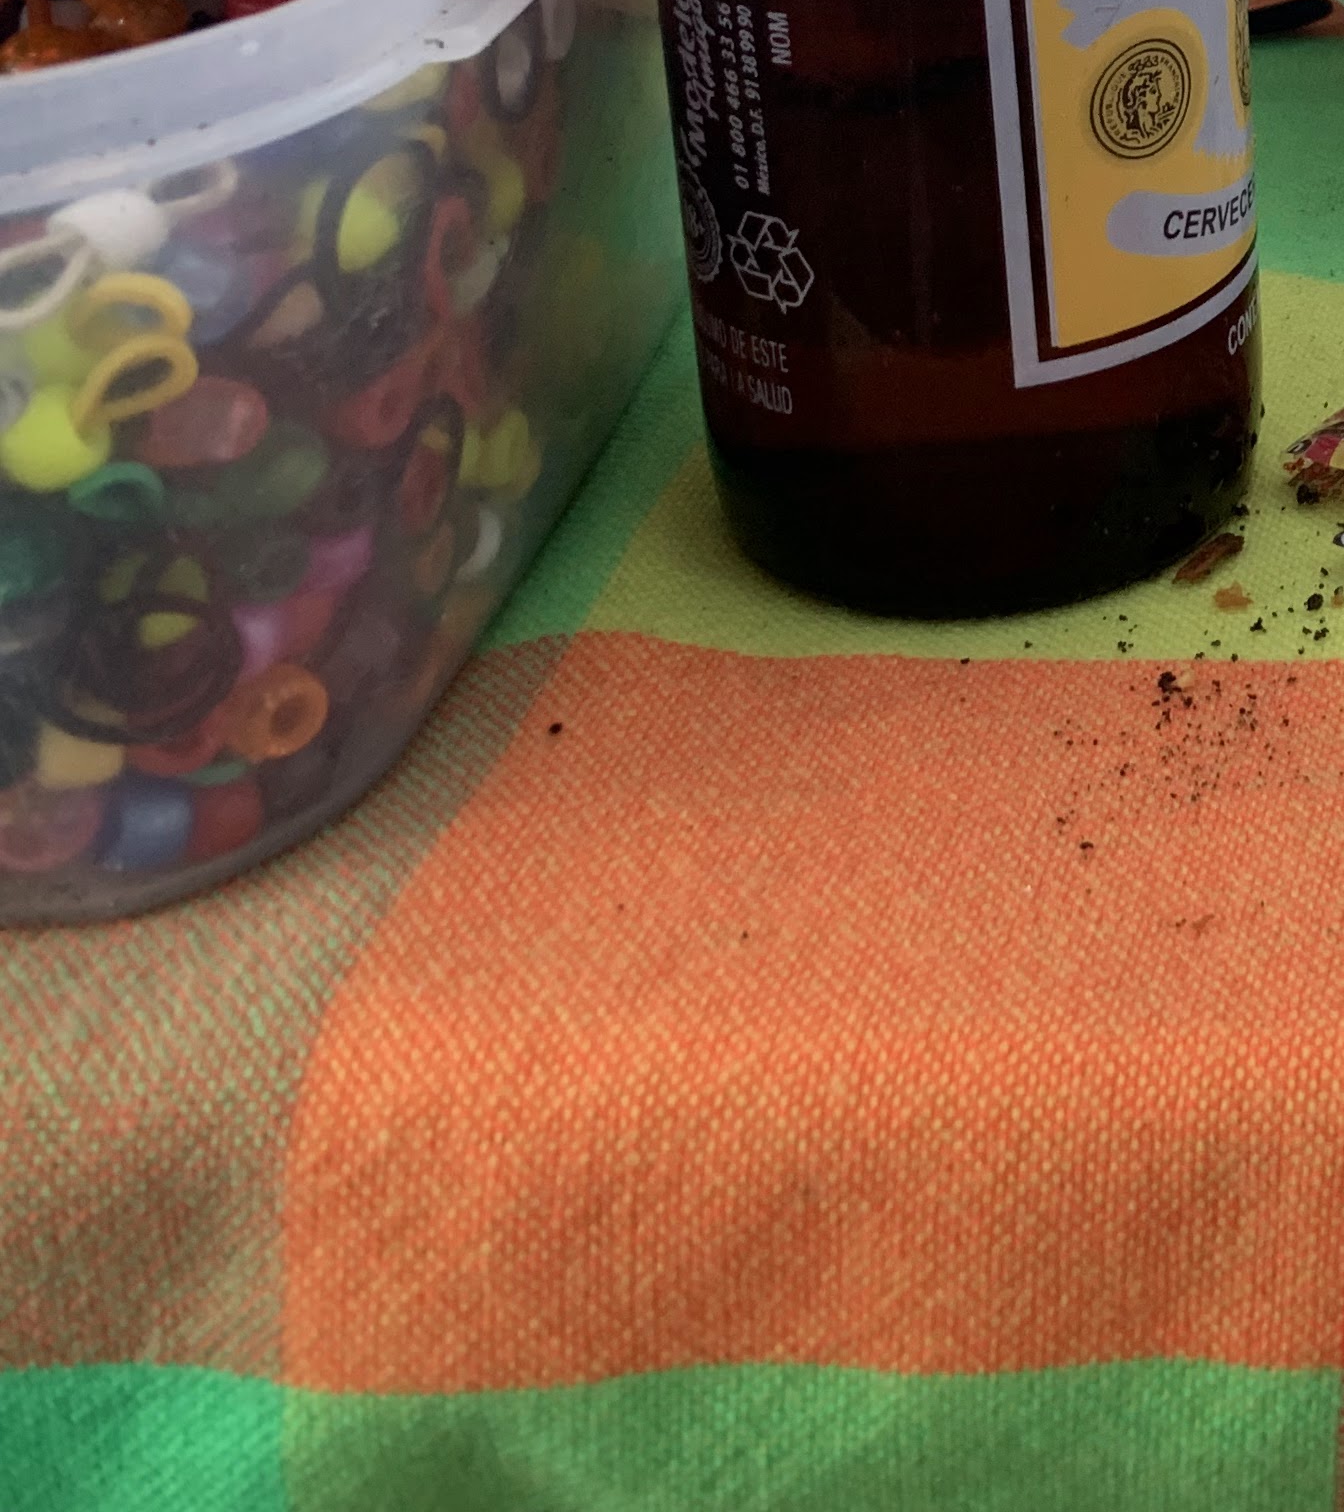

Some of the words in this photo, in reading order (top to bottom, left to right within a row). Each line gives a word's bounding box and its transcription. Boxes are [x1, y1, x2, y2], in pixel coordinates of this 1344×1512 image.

[716, 1, 733, 31] 56
[720, 35, 737, 65] 33
[766, 11, 793, 66] NOM
[724, 67, 742, 111] 466
[727, 114, 747, 158] 800
[734, 163, 750, 189] 01
[730, 325, 748, 359] DE
[751, 335, 789, 373] ESTE
[747, 375, 793, 415] SALUD
